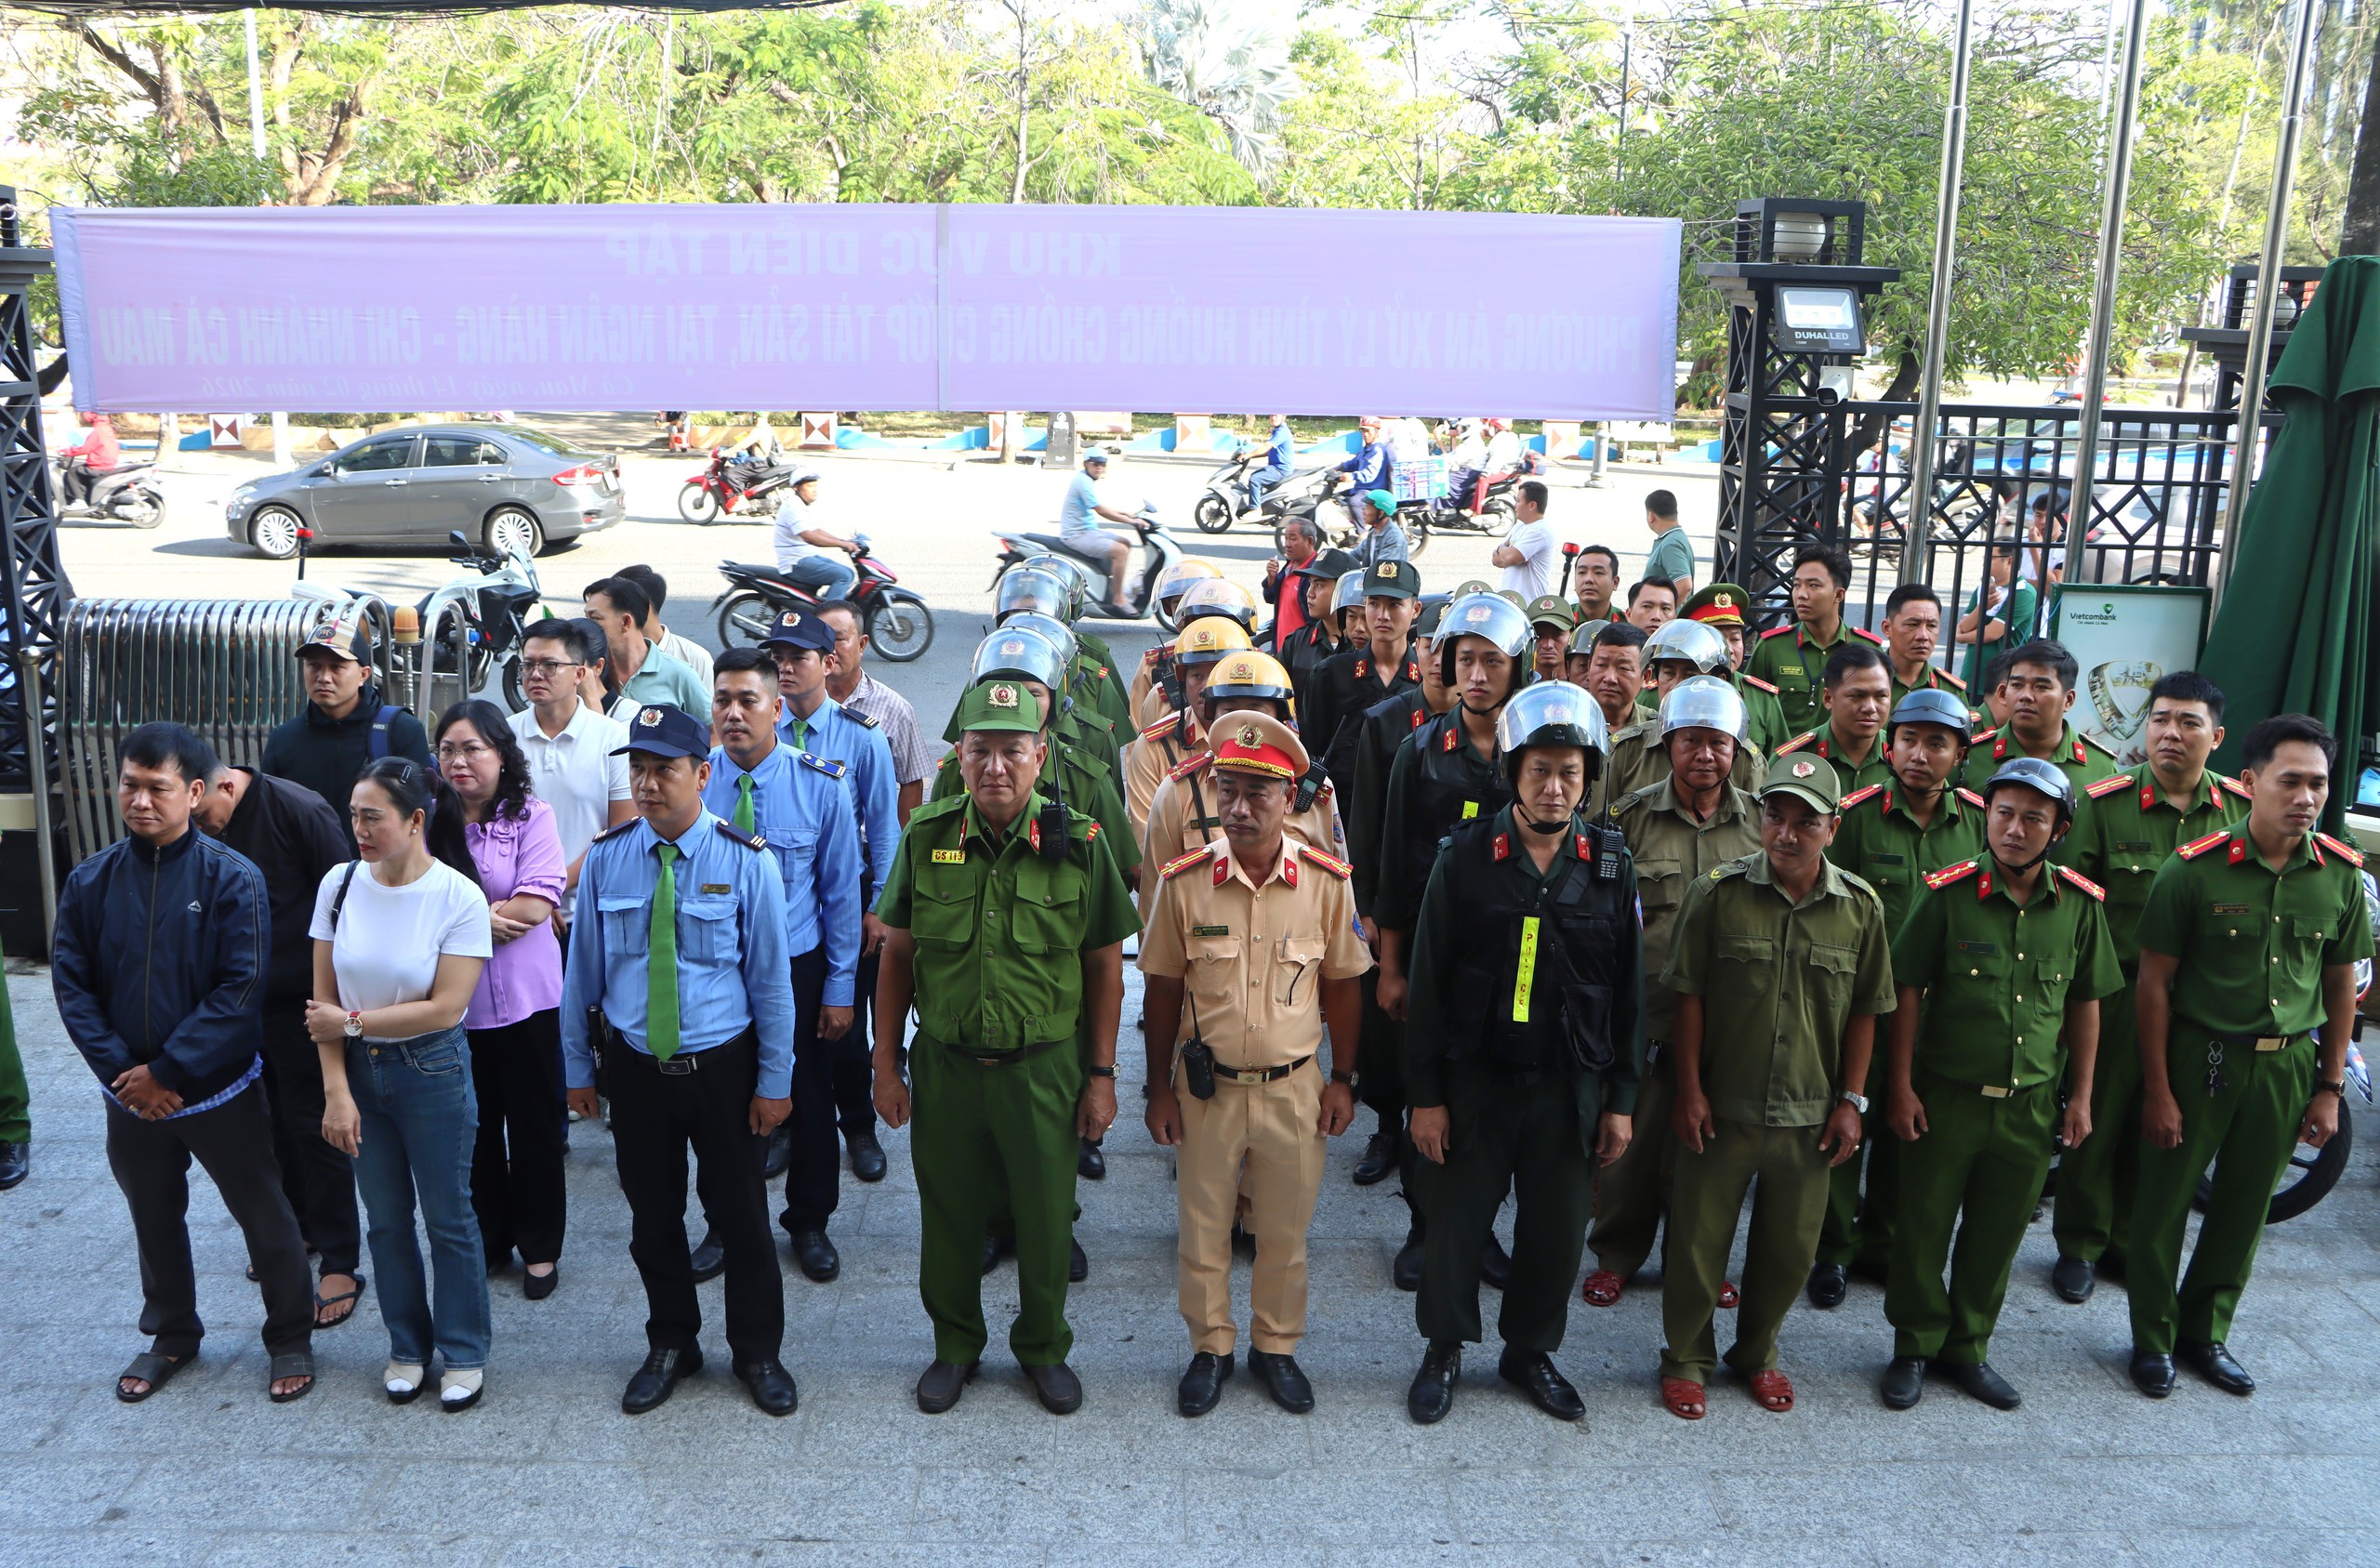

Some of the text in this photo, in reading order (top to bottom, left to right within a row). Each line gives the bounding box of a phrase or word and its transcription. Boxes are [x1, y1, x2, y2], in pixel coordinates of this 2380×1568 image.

[1794, 331, 1849, 340] DUHALLED
[2069, 613, 2118, 621] Vietcombank
[948, 851, 963, 861] 113
